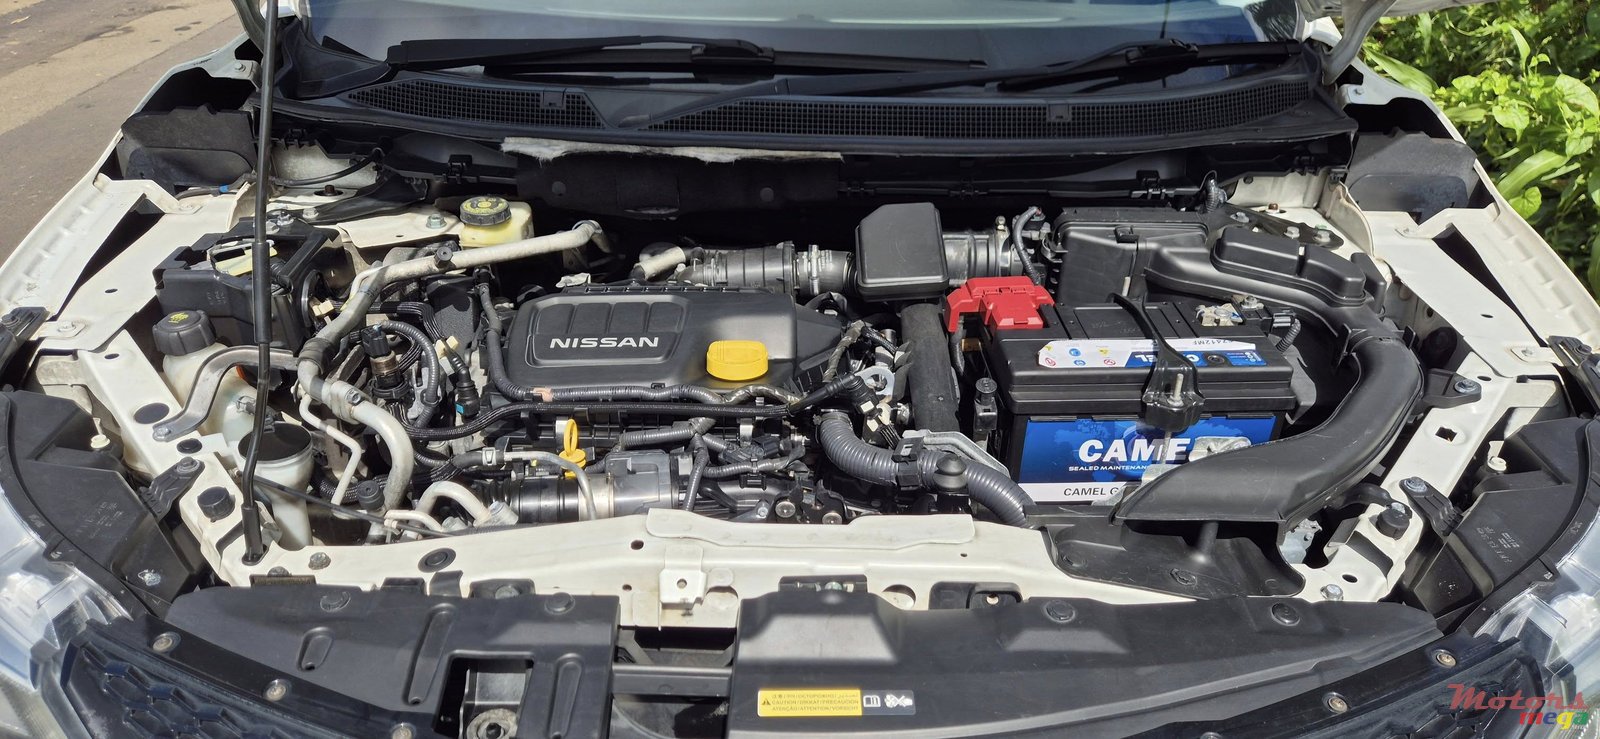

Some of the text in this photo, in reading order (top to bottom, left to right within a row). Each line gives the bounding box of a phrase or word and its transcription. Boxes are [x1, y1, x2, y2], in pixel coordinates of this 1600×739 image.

[550, 337, 658, 349] NISSAN
[1078, 439, 1190, 462] CAME
[1064, 488, 1106, 496] CAMEL
